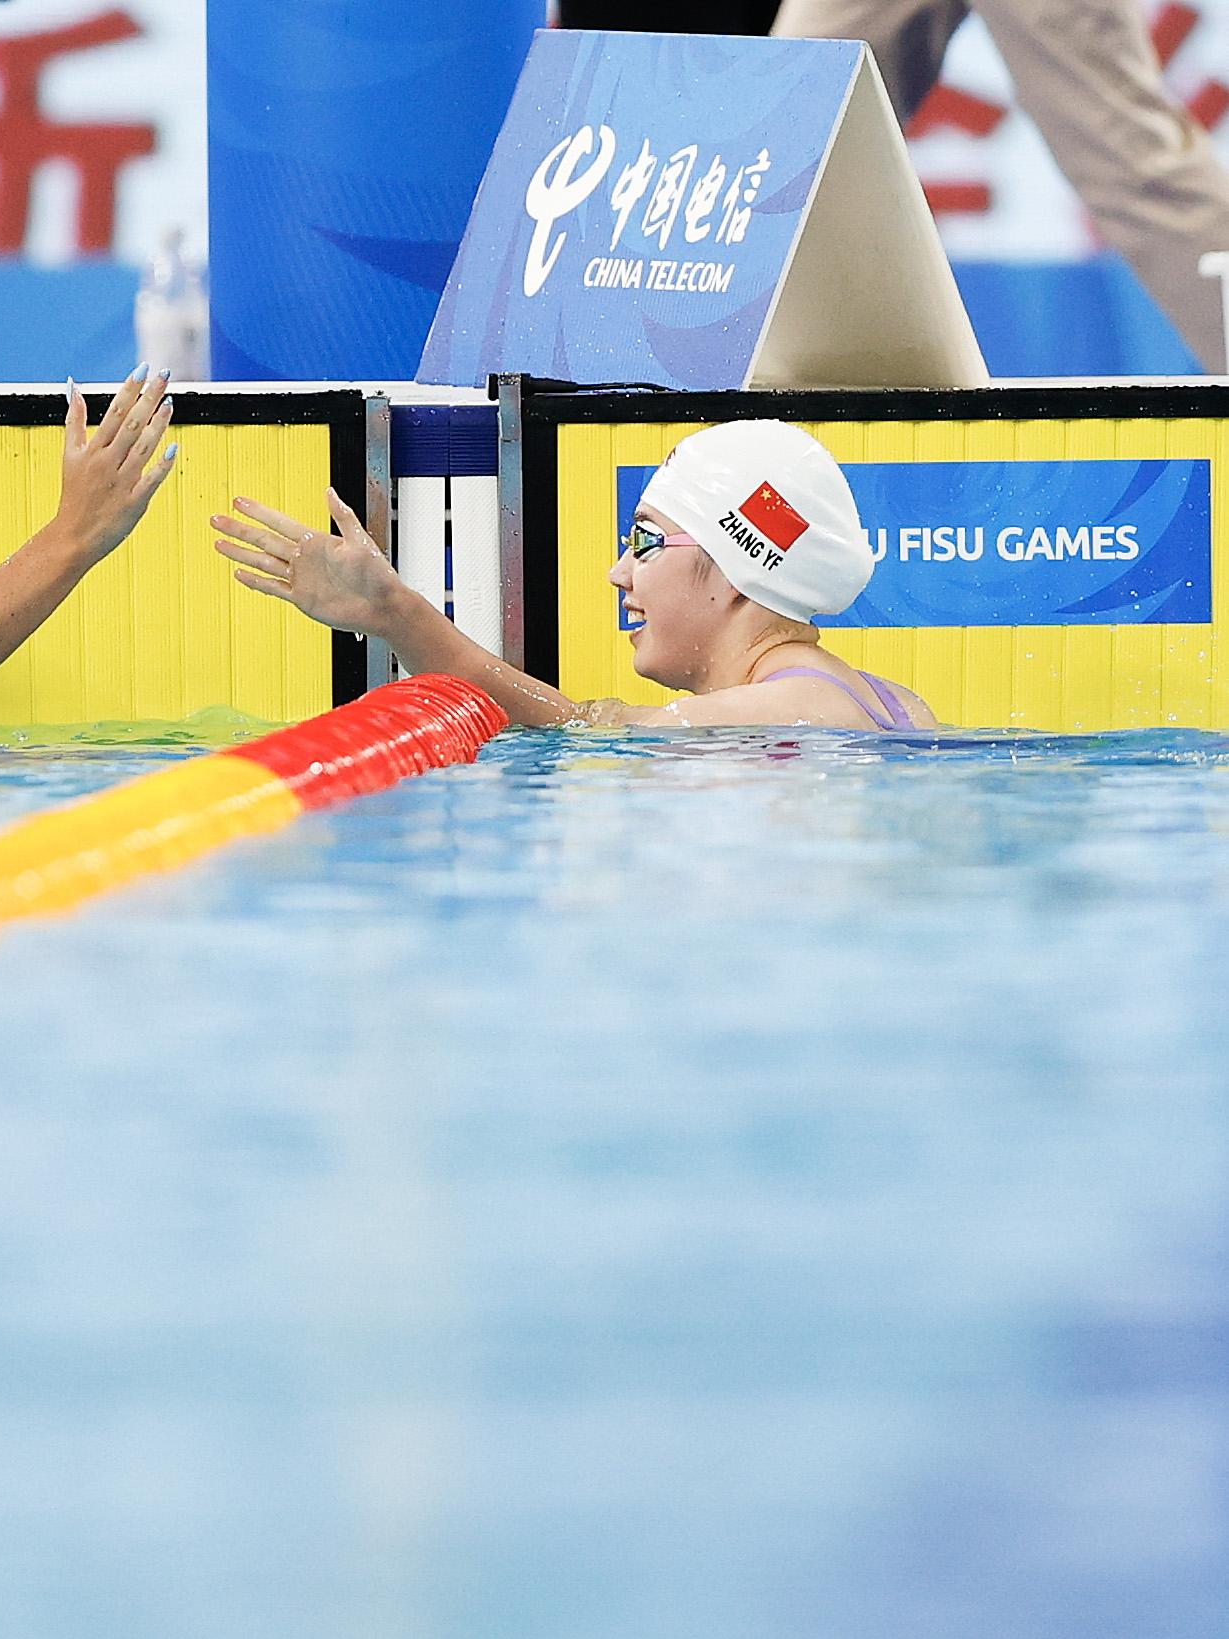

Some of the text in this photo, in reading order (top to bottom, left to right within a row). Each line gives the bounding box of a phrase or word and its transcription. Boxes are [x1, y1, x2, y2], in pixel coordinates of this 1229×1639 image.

[610, 138, 771, 252] 中国电信
[583, 256, 735, 292] CHINA TELECOM
[718, 510, 784, 571] ZHANG YF
[898, 526, 985, 562] FISU
[996, 525, 1140, 562] GAMES
